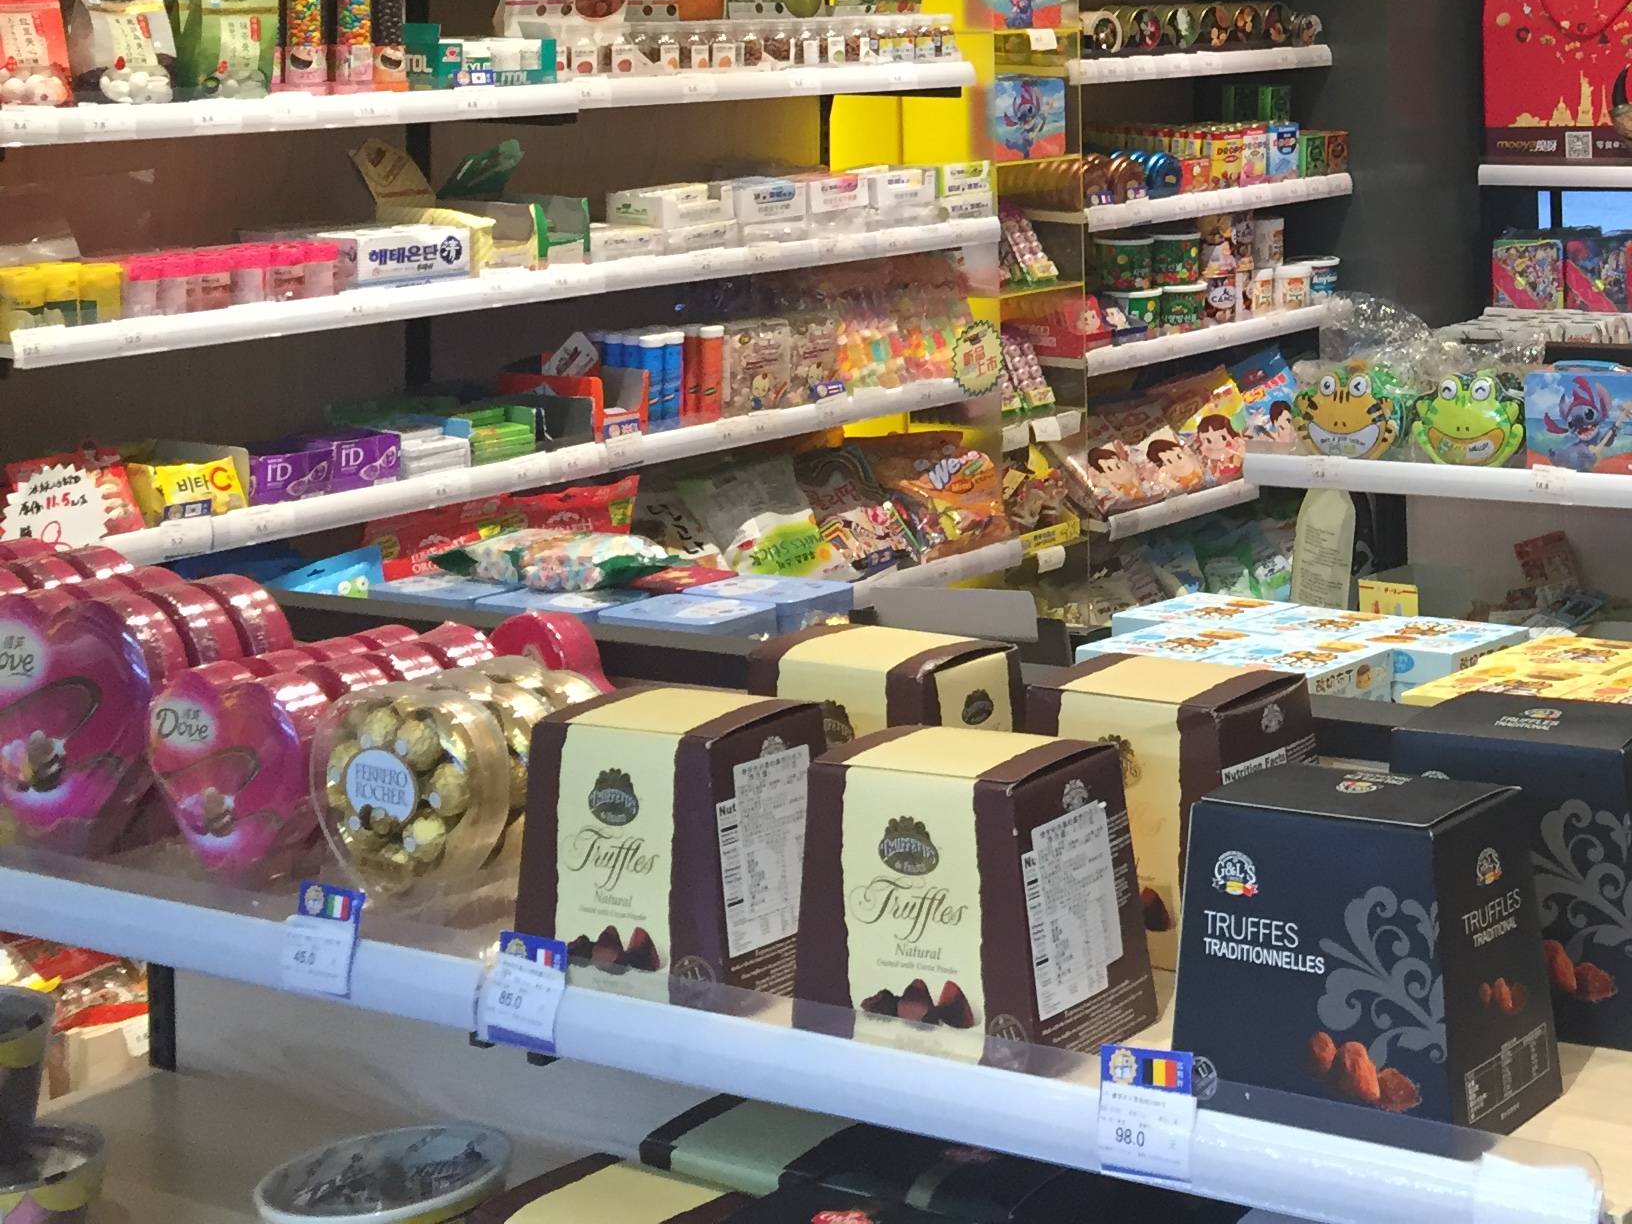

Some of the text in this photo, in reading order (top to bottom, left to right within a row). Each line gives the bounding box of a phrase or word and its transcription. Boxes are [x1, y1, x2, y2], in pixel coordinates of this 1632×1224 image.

[368, 243, 438, 265] 해태은단
[155, 708, 209, 742] Dove
[354, 765, 408, 786] FERRERO
[1223, 752, 1286, 783] Nutrition Facts
[355, 782, 408, 805] ROCHER
[564, 826, 660, 892] Truffles
[594, 891, 632, 907] Natural
[851, 876, 968, 943] Truffles
[1461, 888, 1521, 936] TRUFFLES
[1204, 910, 1298, 948] TRUFFES
[895, 944, 942, 961] Natural
[1203, 937, 1325, 975] TRADITIONNELLES
[1115, 1127, 1145, 1147] 98.0
